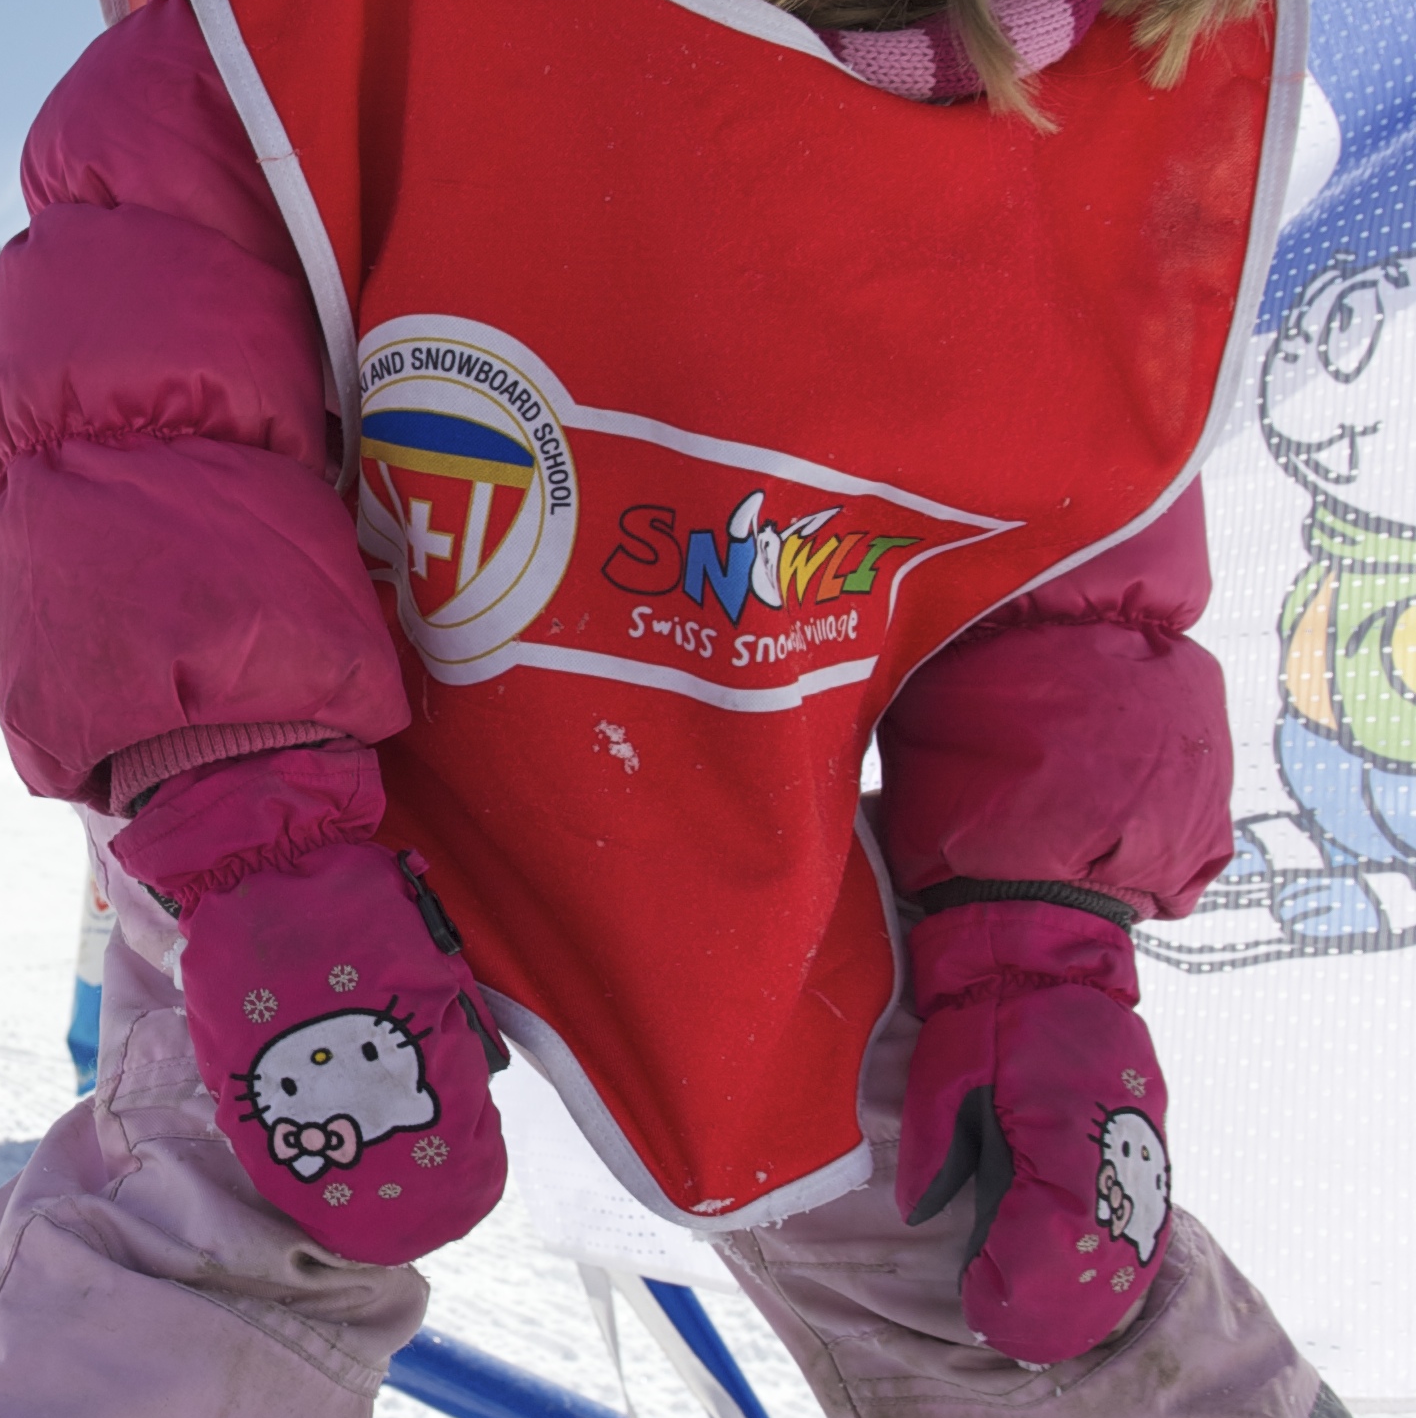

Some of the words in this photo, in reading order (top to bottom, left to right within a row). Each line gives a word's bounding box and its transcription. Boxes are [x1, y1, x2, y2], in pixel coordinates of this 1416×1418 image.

[370, 351, 405, 386] AND
[411, 347, 541, 423] SNOWBOARD
[534, 423, 572, 516] SCHOOL
